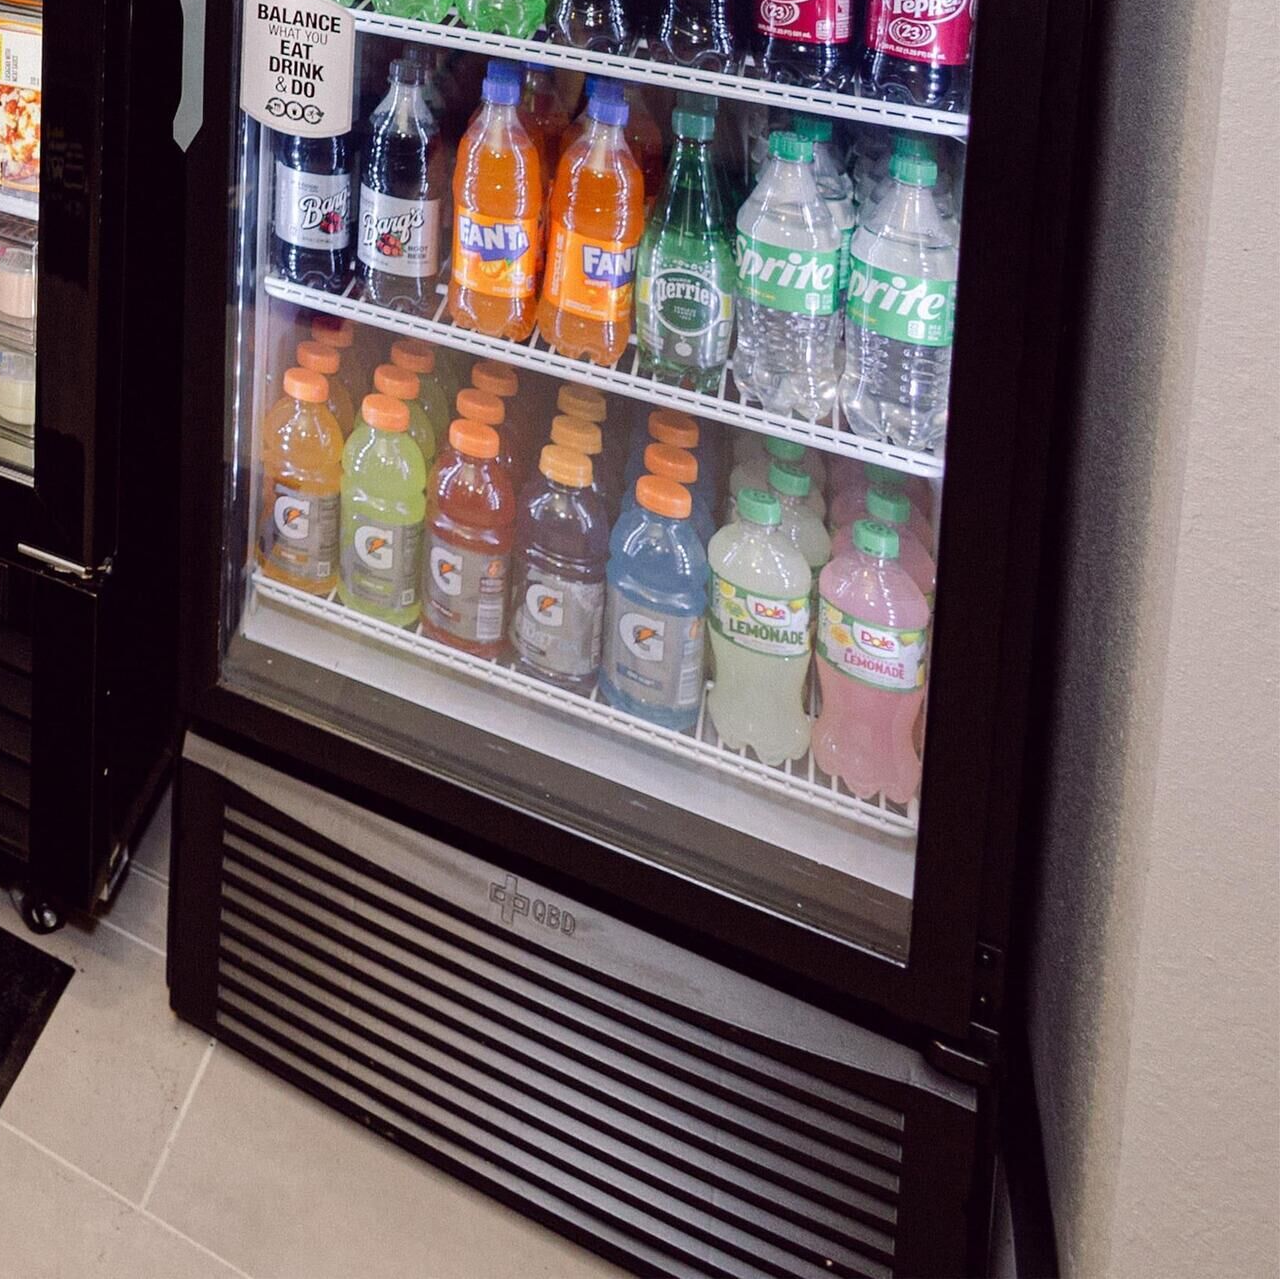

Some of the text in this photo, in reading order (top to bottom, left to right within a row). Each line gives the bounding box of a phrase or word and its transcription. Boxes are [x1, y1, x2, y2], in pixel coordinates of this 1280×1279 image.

[258, 3, 341, 34] BALANCE
[769, 4, 785, 20] 23
[269, 24, 328, 45] WHAT YOU
[901, 23, 921, 38] 23
[269, 56, 324, 82] DRINK
[275, 75, 315, 98] & DO
[363, 208, 425, 246] Barq's
[459, 215, 528, 251] FANTA
[583, 245, 638, 277] FANT
[656, 277, 718, 311] Perrier
[848, 271, 946, 321] prite
[754, 602, 786, 619] Dole
[729, 618, 804, 646] LEMONADE
[861, 630, 895, 650] Dole
[844, 652, 905, 680] LEMONADE
